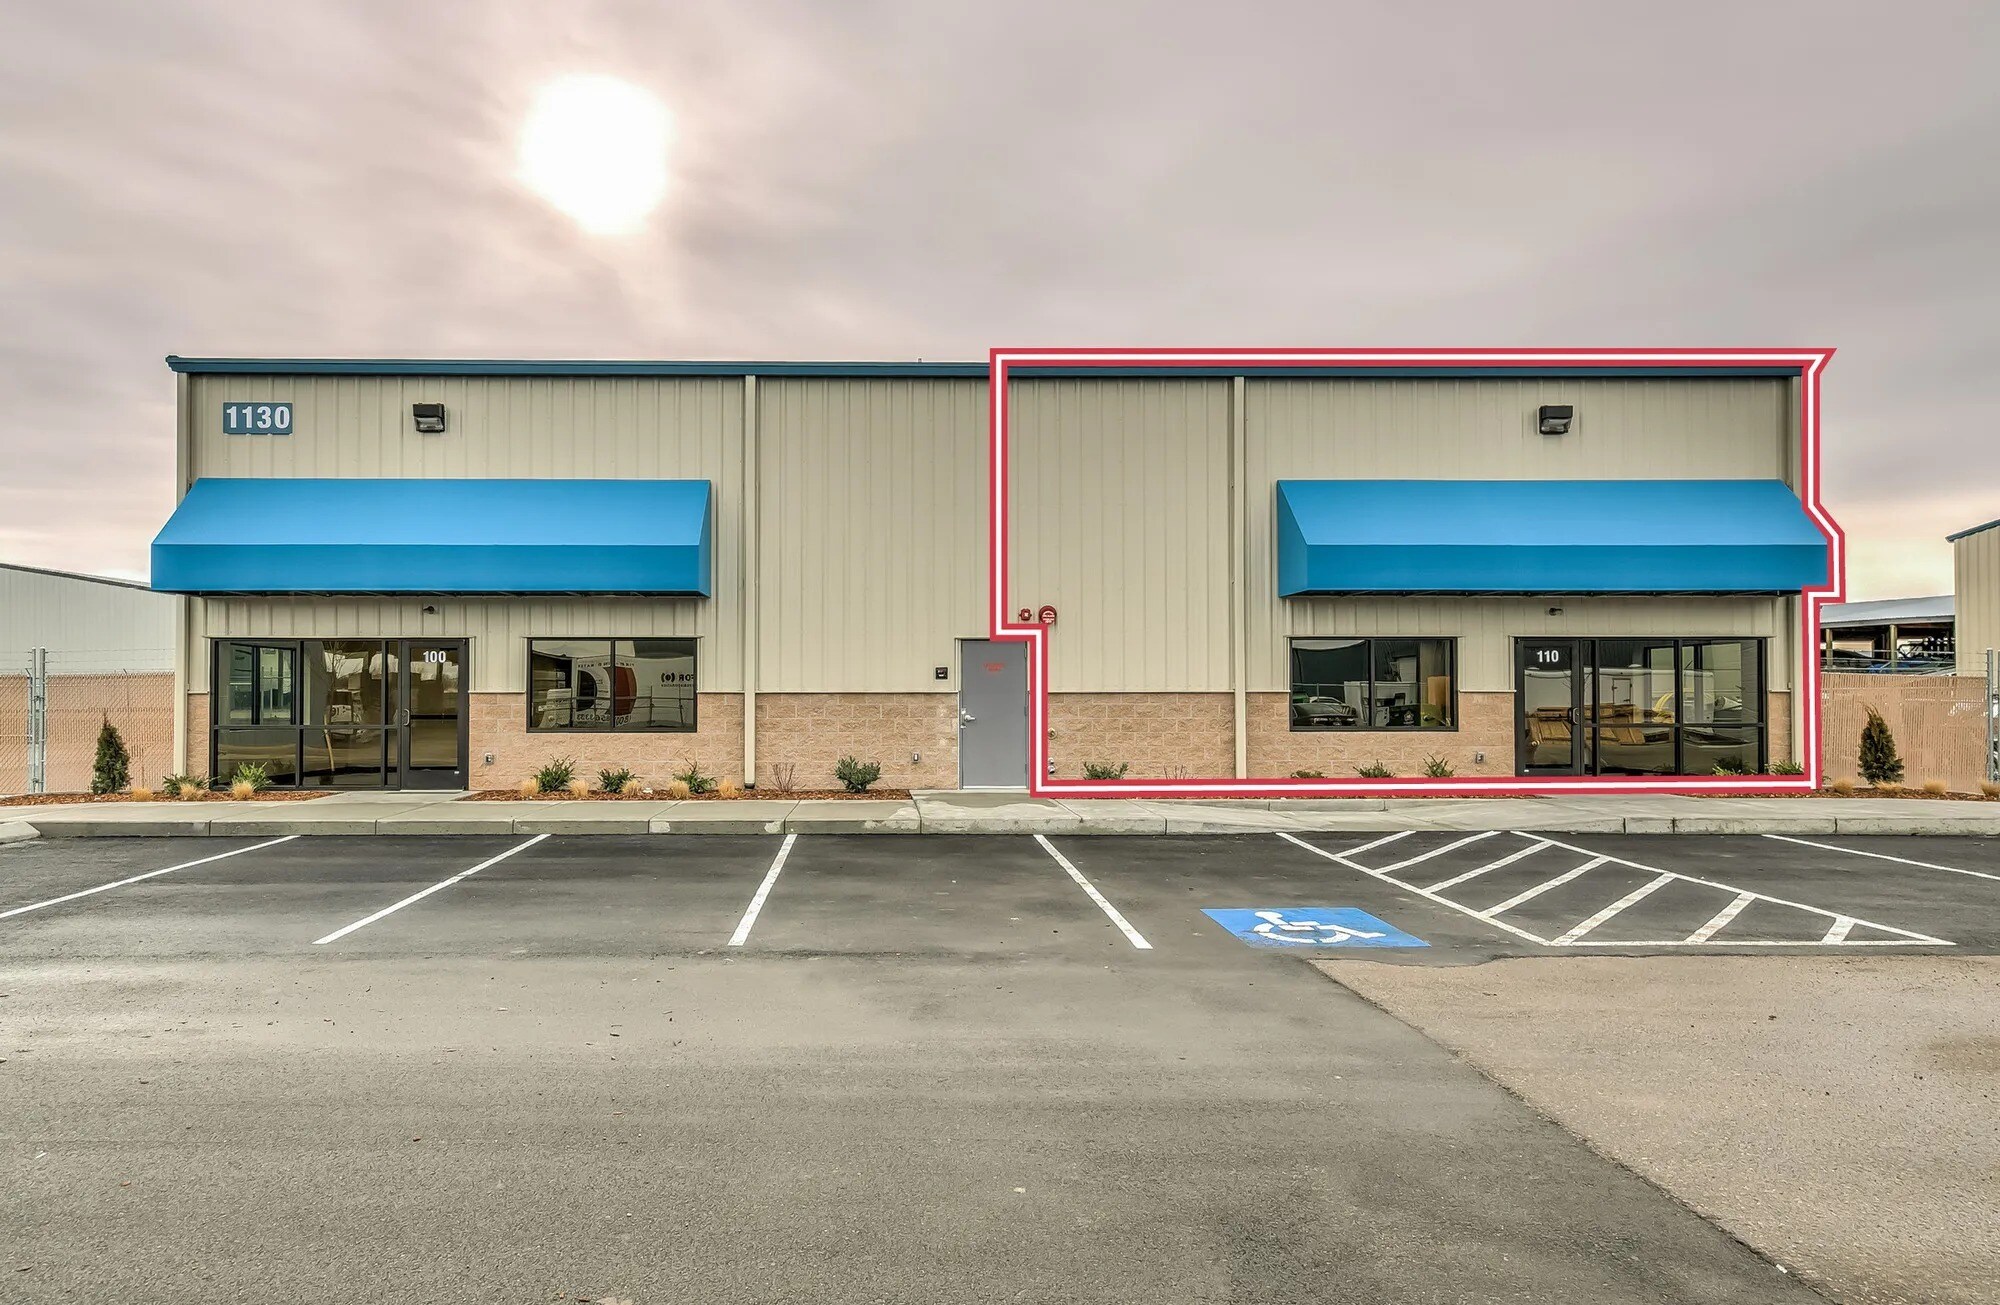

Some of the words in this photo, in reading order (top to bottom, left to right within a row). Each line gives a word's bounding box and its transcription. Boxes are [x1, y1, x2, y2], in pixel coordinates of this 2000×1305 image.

[226, 406, 290, 429] 1130
[422, 650, 447, 663] 100
[1536, 650, 1559, 663] 110
